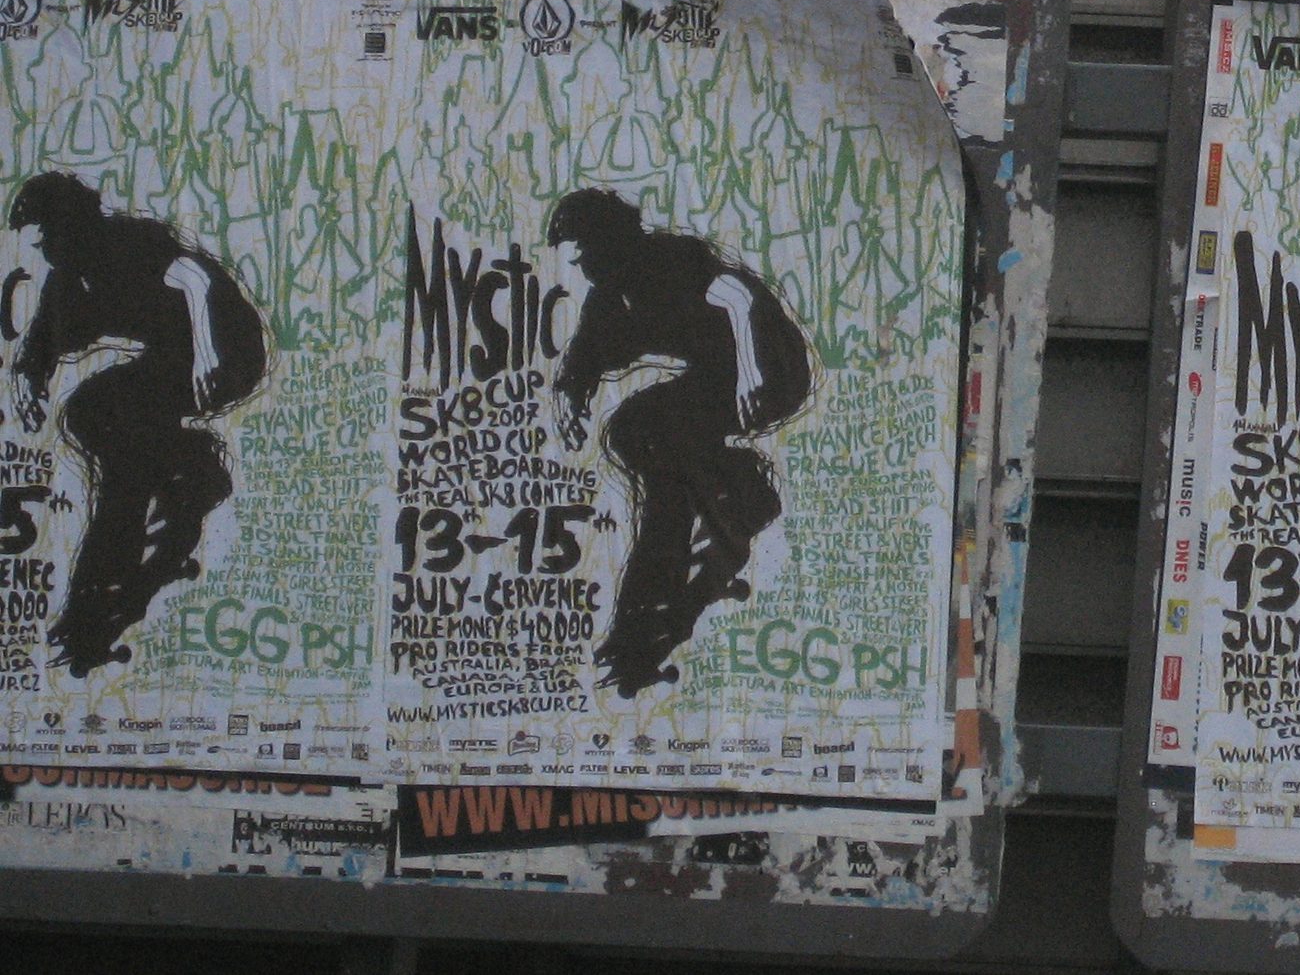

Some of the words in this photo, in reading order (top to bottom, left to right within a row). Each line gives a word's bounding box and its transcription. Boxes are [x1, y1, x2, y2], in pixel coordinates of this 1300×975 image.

[413, 4, 497, 42] VANS
[396, 388, 483, 439] SK8
[486, 371, 544, 407] CUP
[489, 403, 540, 426] 2007
[395, 432, 501, 466] WORLD
[506, 427, 548, 457] CUP
[0, 463, 55, 486] NTEST
[394, 455, 596, 491] SKATEBOARDING
[424, 488, 476, 507] REAL
[520, 482, 598, 505] CONTEST
[1173, 539, 1190, 584] DNES
[177, 598, 290, 666] EGG
[390, 613, 444, 640] PRIZE
[447, 614, 506, 640] MONEY
[391, 642, 439, 675] PRO
[447, 641, 521, 658] RIDERS
[526, 641, 583, 657] FROM
[525, 657, 587, 671] BRASIL
[726, 618, 841, 687] EGG
[1222, 652, 1278, 679] PRIZE
[445, 683, 526, 696] EUROPE
[545, 680, 583, 692] USA
[1223, 681, 1272, 715] PRO
